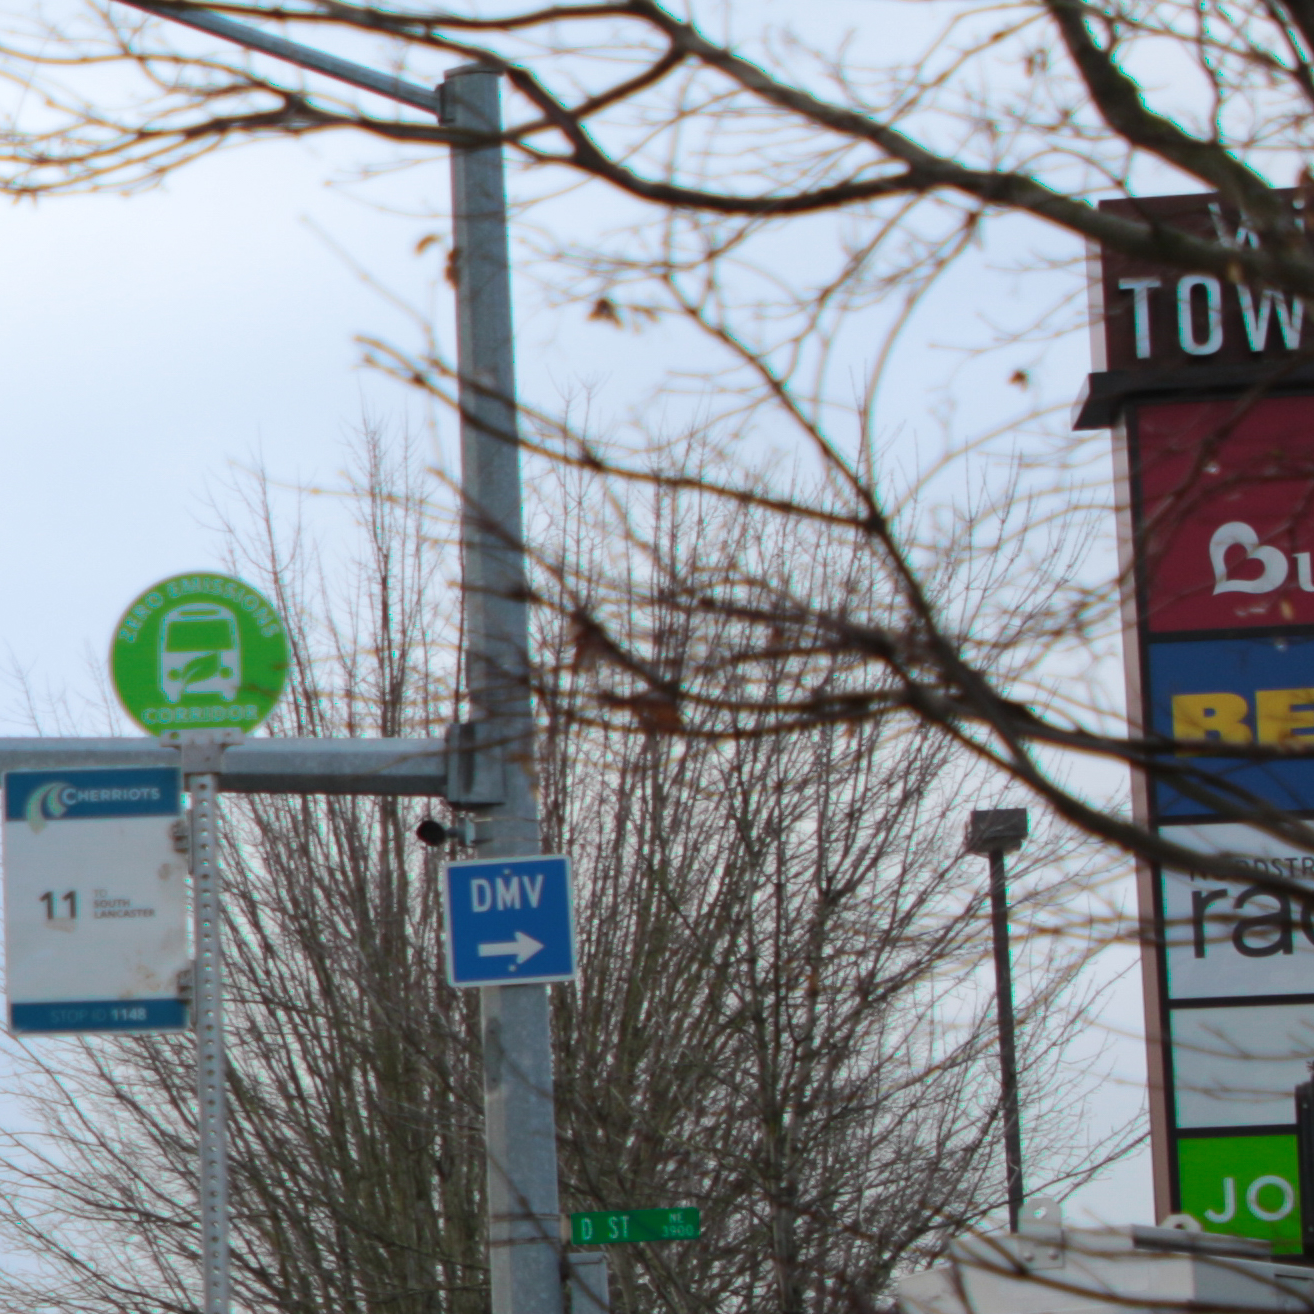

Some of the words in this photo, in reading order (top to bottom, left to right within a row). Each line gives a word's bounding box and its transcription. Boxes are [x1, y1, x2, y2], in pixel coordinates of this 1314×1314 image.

[117, 591, 164, 643] ZERO
[166, 577, 280, 638] EMISSIONS
[141, 704, 258, 724] CORRIDOR
[62, 787, 161, 807] CHERRIOTS
[39, 889, 78, 920] 11
[93, 889, 108, 898] TO
[93, 899, 131, 908] SOUTH
[471, 874, 545, 913] DMV
[93, 908, 156, 919] LANCASTER
[1191, 884, 1314, 959] ra
[581, 1217, 592, 1240] D
[608, 1215, 630, 1239] ST
